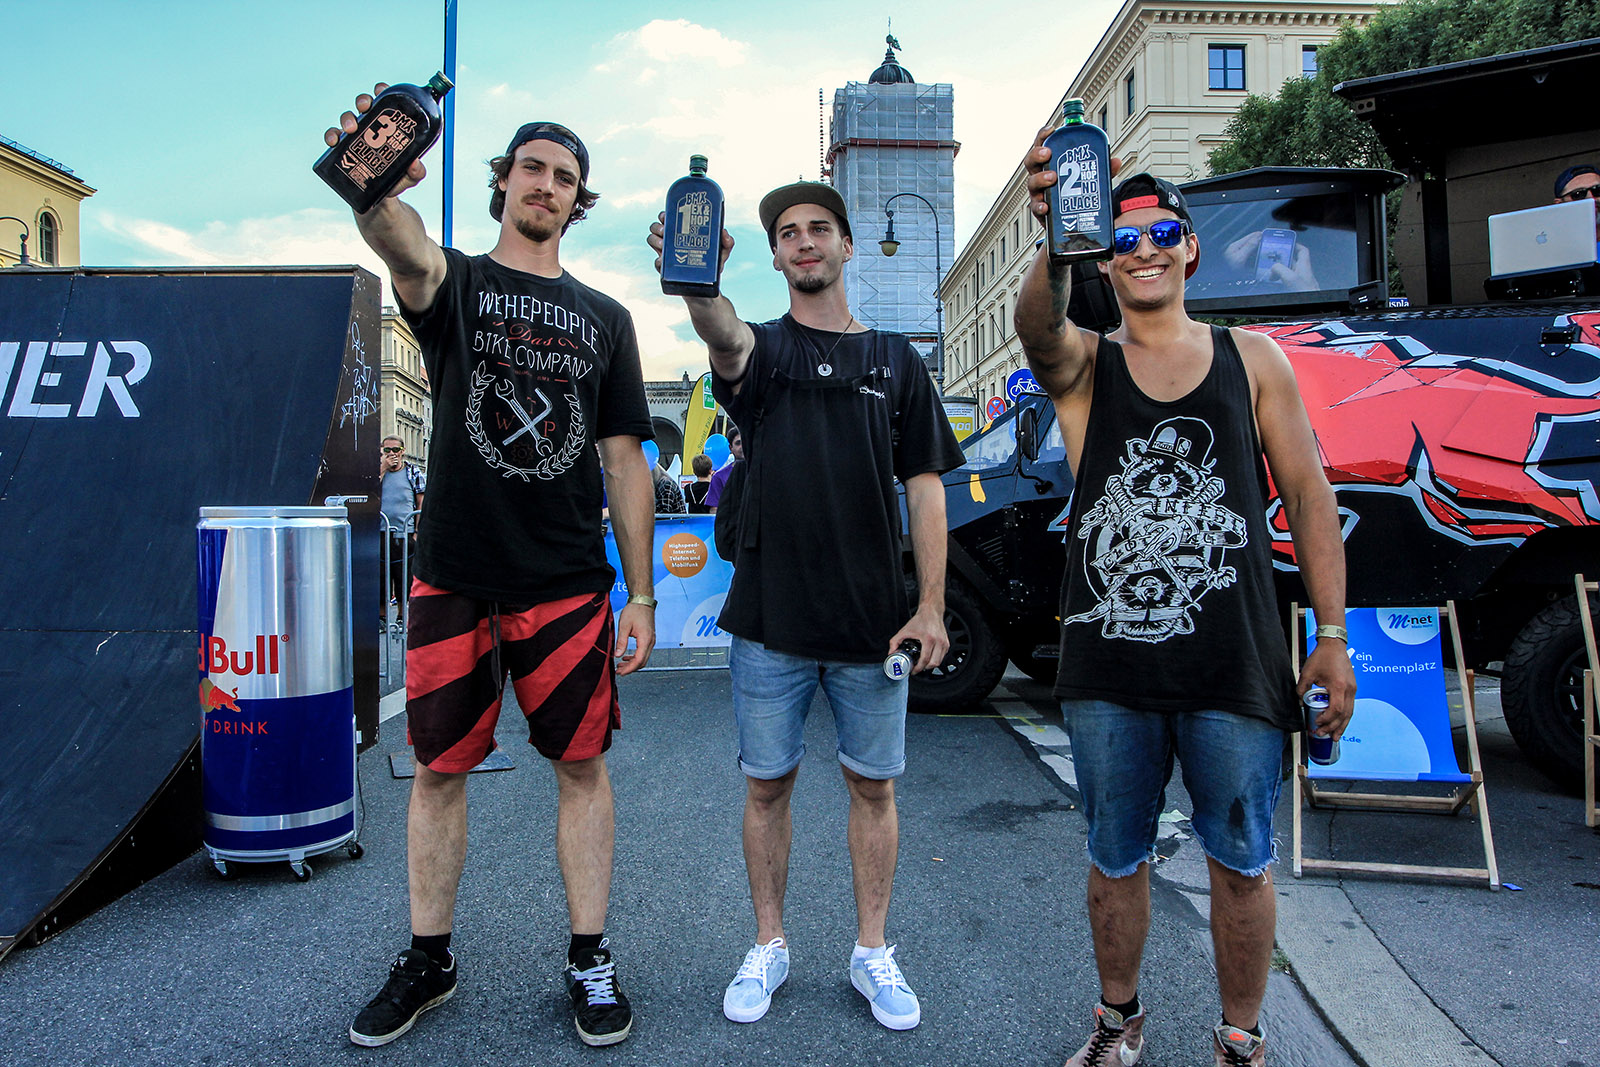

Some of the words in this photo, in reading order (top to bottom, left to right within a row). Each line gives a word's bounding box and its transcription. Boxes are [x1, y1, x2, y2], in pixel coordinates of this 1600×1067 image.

[391, 110, 417, 133] BMX
[364, 115, 397, 149] 3
[378, 145, 396, 162] RD
[387, 137, 404, 153] HOP
[1066, 144, 1090, 163] BMX
[352, 141, 387, 175] PLACE
[1060, 162, 1082, 197] 2
[1081, 170, 1096, 181] HOP
[1082, 181, 1097, 194] ND
[685, 191, 708, 206] BMX
[1062, 197, 1099, 212] PLACE
[678, 203, 691, 235] 1
[691, 204, 702, 216] EX
[691, 215, 710, 227] HOP
[675, 235, 709, 248] PLACE
[478, 290, 599, 355] WEHEPEOPLE
[508, 322, 554, 347] Das
[472, 330, 511, 360] BIKE
[515, 345, 593, 379] COMPANY
[208, 635, 279, 676] Bull
[1361, 661, 1437, 675] Sonnenplatz
[213, 719, 269, 735] DRINK
